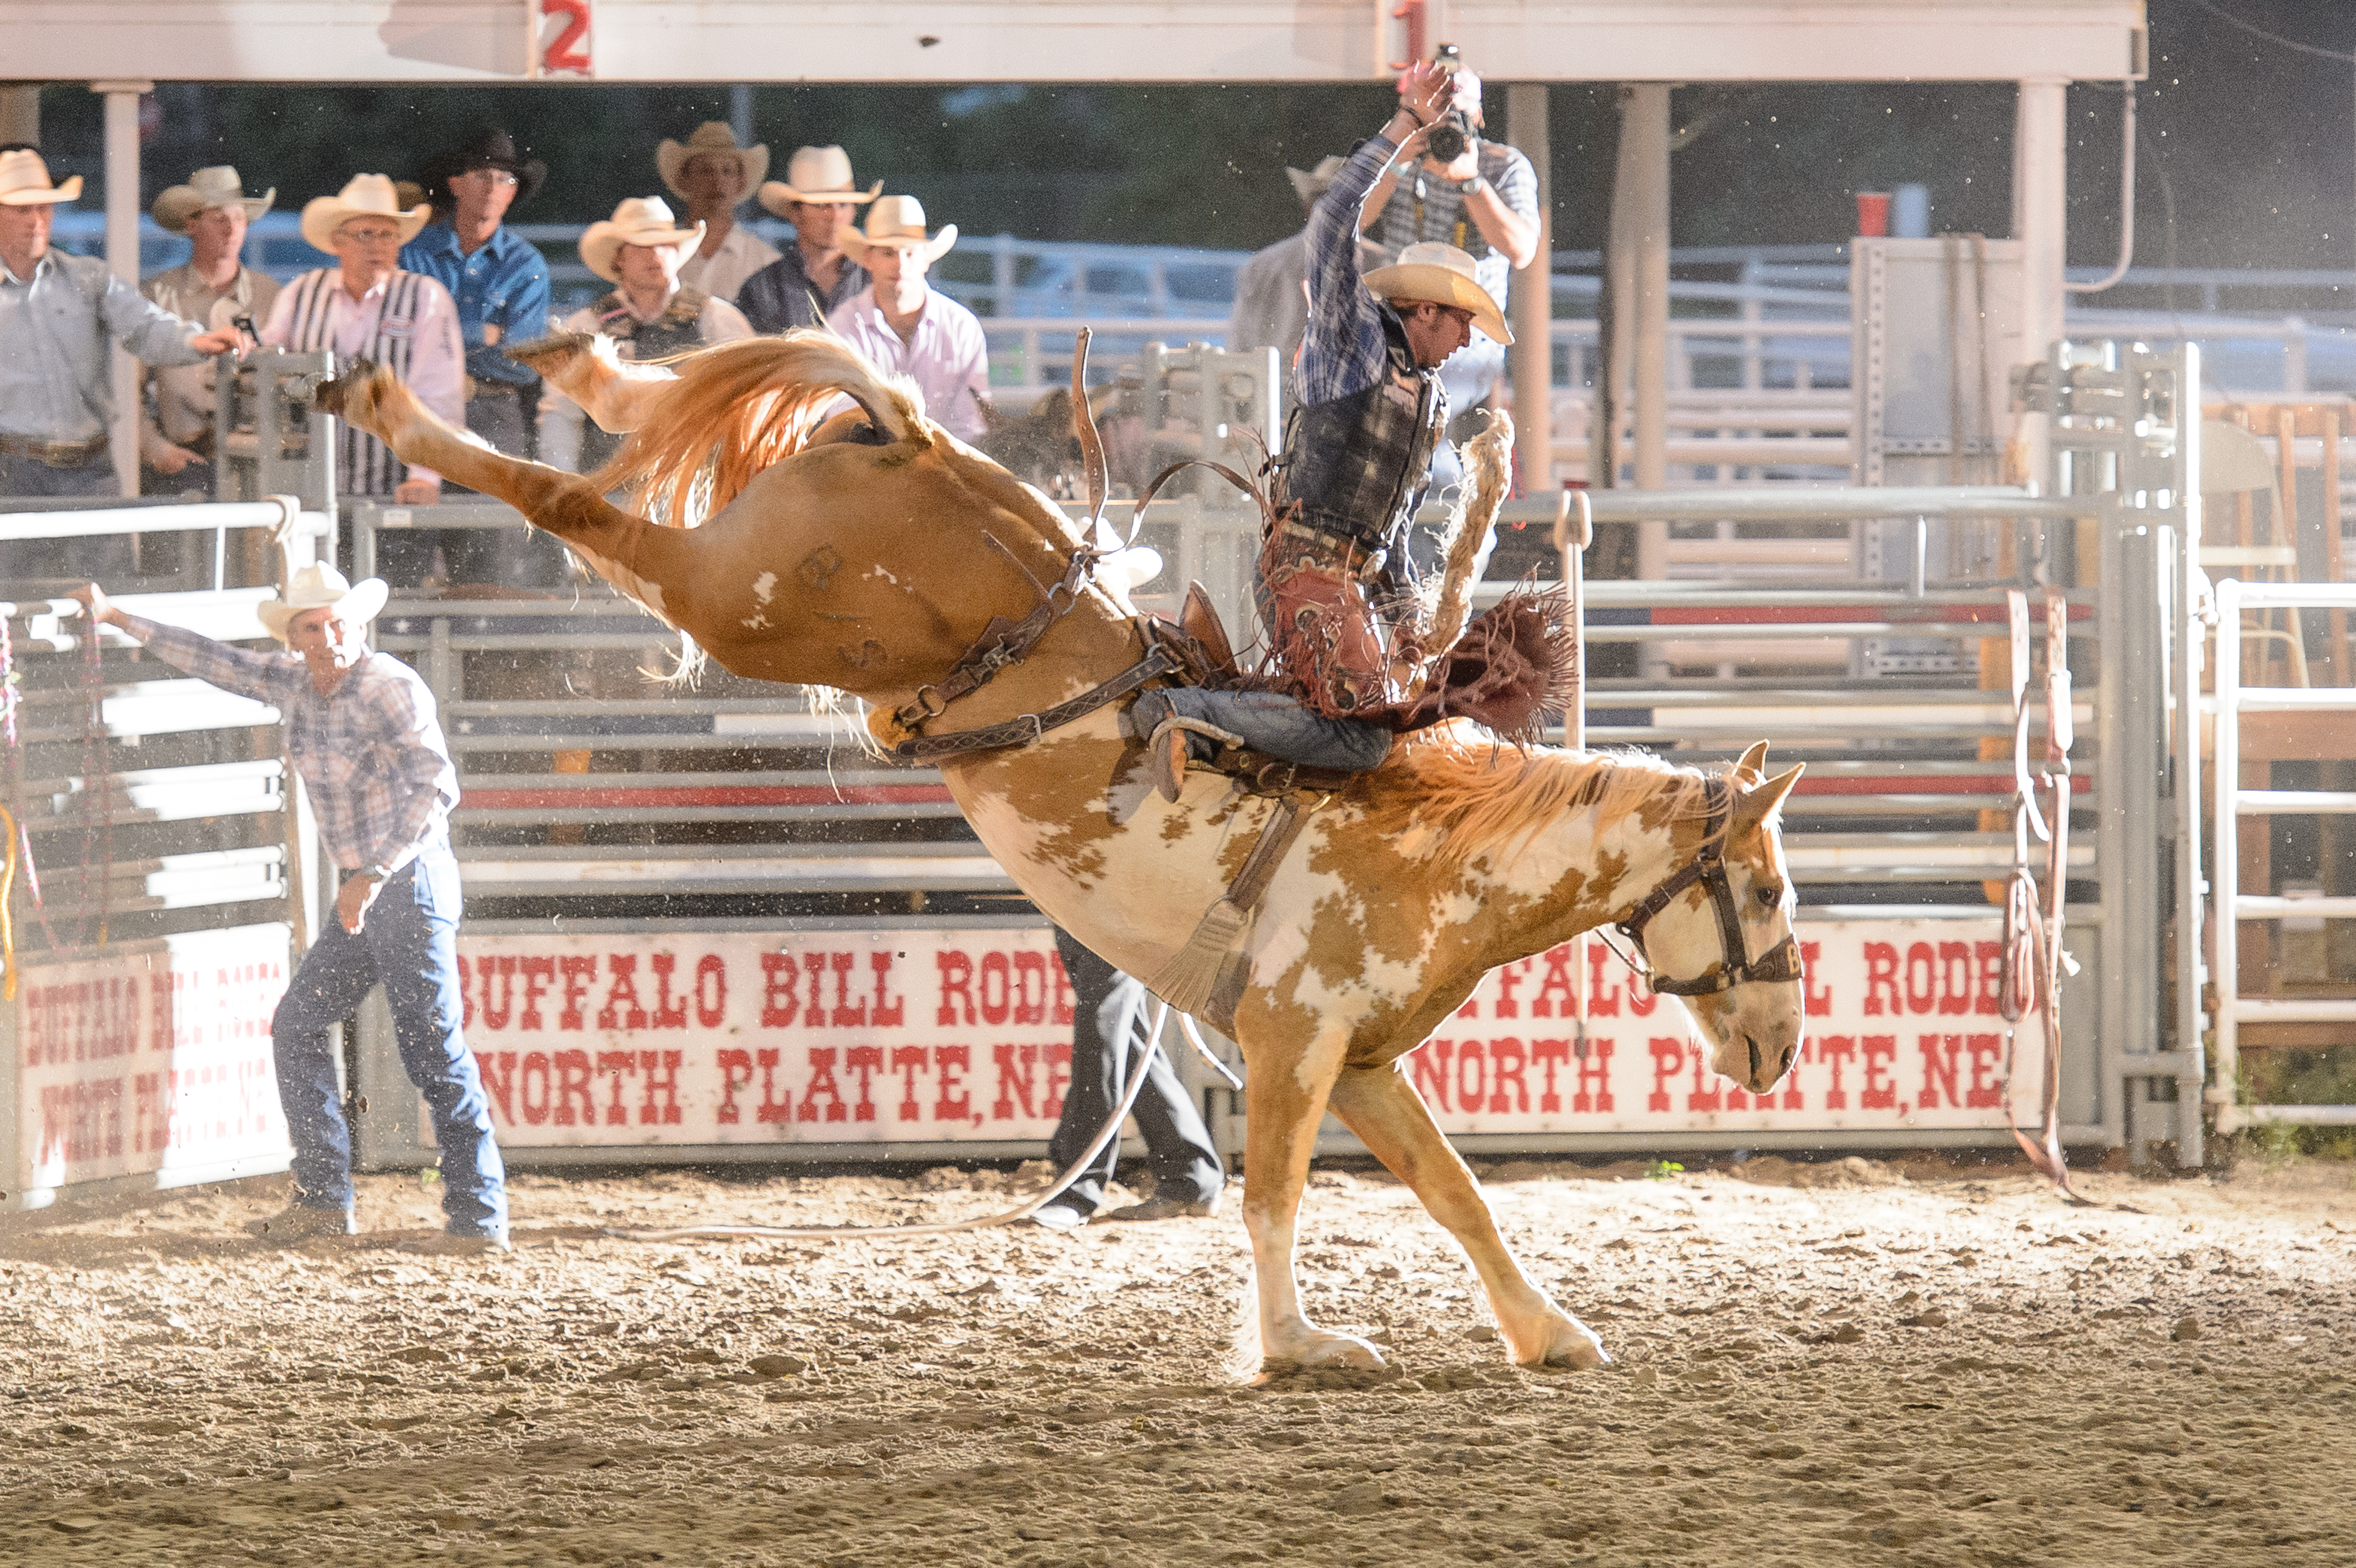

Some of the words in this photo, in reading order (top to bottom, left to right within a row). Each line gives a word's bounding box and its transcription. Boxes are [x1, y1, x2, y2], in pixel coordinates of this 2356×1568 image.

[542, 0, 591, 70] 2
[1389, 0, 1428, 69] 1
[761, 951, 905, 1028] BILL
[473, 1049, 682, 1126] NORTH
[1411, 1037, 1616, 1113] NORTH
